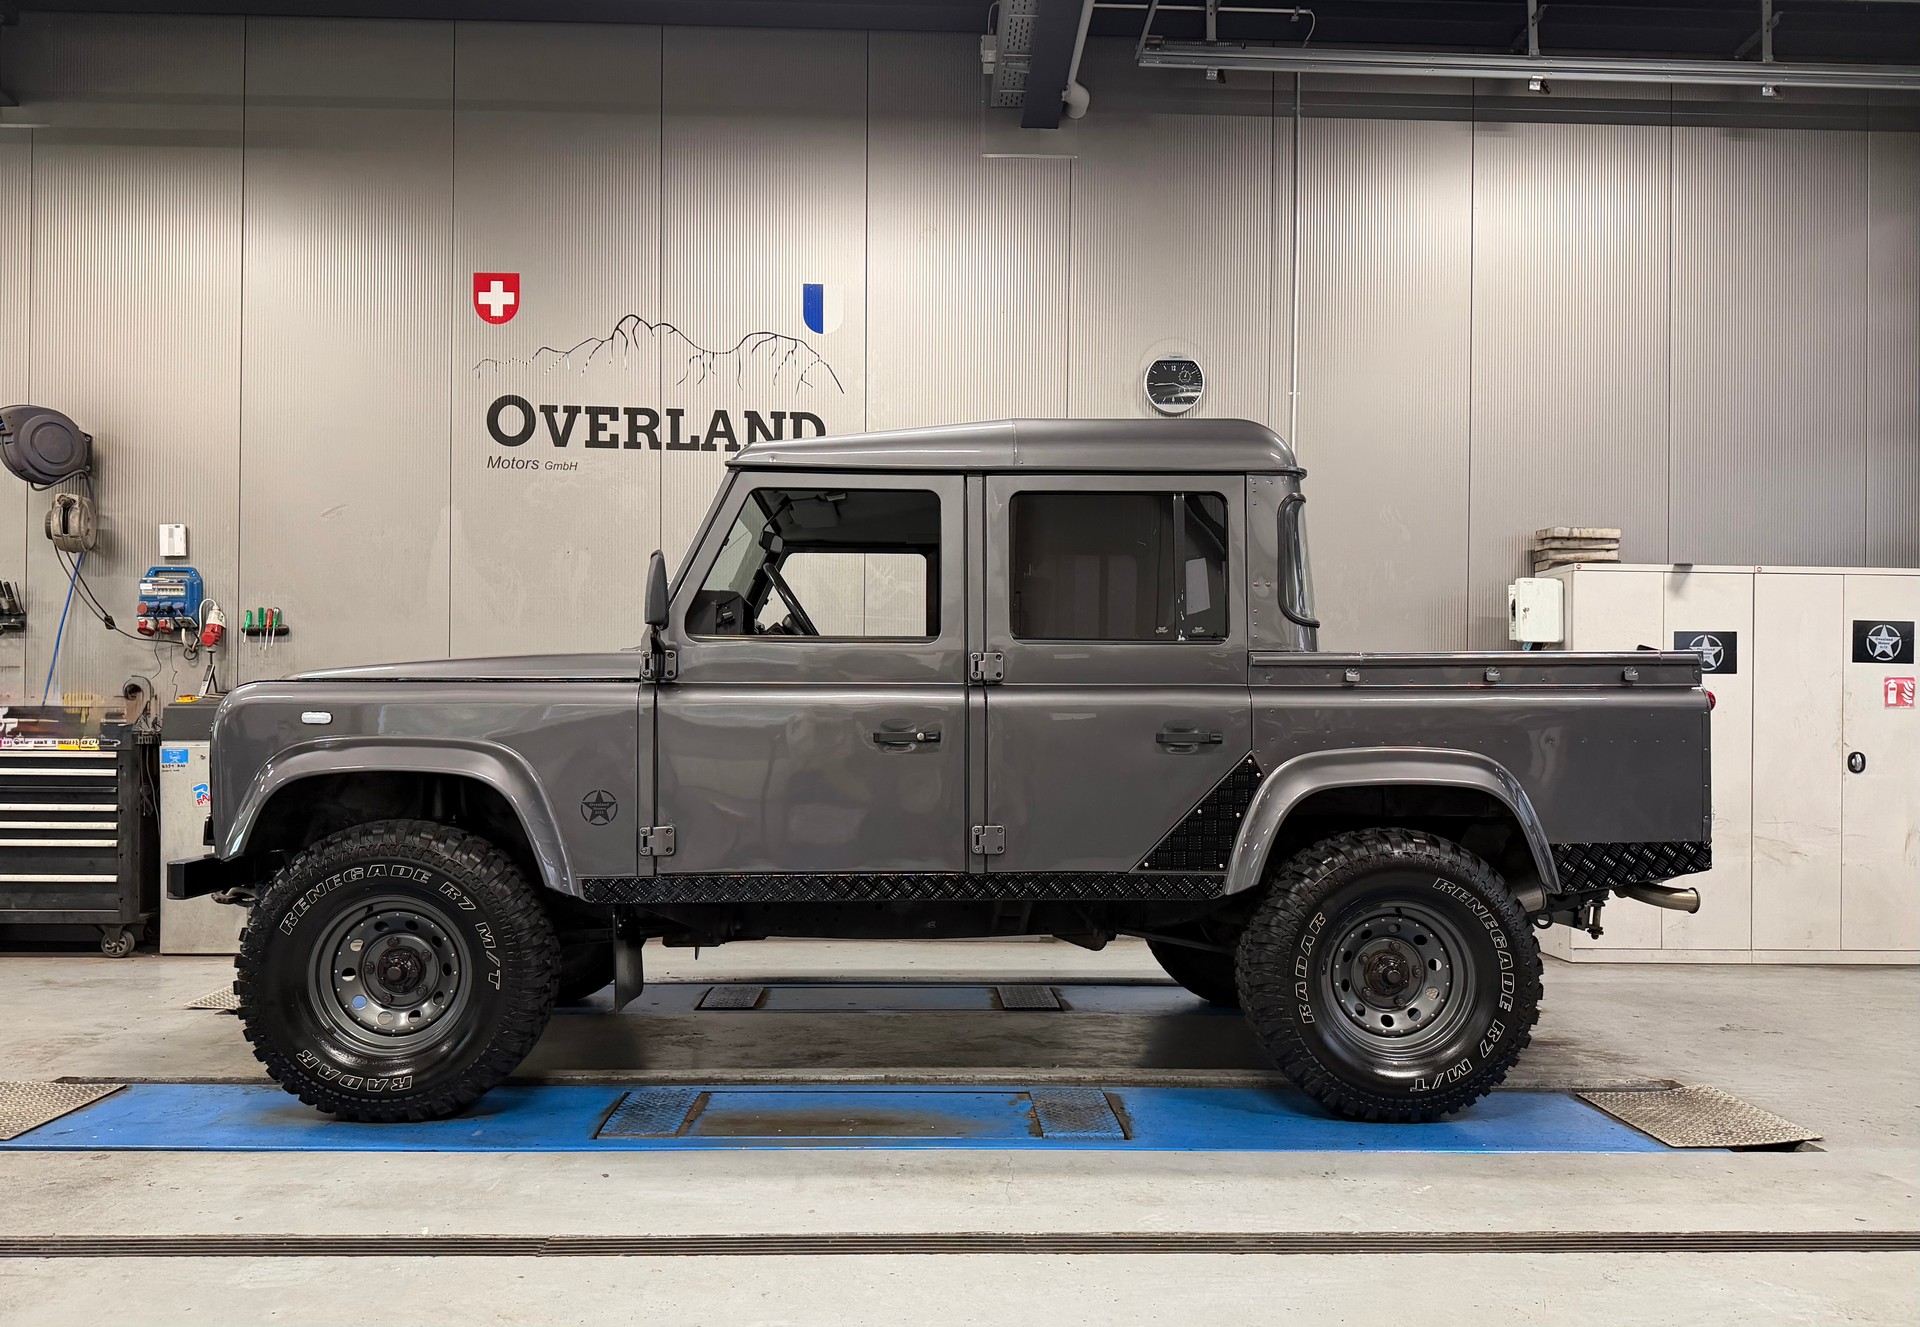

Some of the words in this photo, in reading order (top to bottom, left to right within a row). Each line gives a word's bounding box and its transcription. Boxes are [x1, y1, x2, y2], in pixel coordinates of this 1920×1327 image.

[486, 394, 826, 452] OVERLAND
[487, 456, 540, 470] Motors
[545, 461, 578, 471] GmbH
[279, 864, 433, 935] RENEGADE
[439, 881, 476, 911] R7
[474, 921, 501, 990] M/T
[1432, 877, 1515, 1012] RENEGADE
[1295, 911, 1326, 1024] RADAR
[1480, 1019, 1506, 1058] R7
[295, 1050, 413, 1092] RADAR
[1410, 1058, 1473, 1092] M/T
